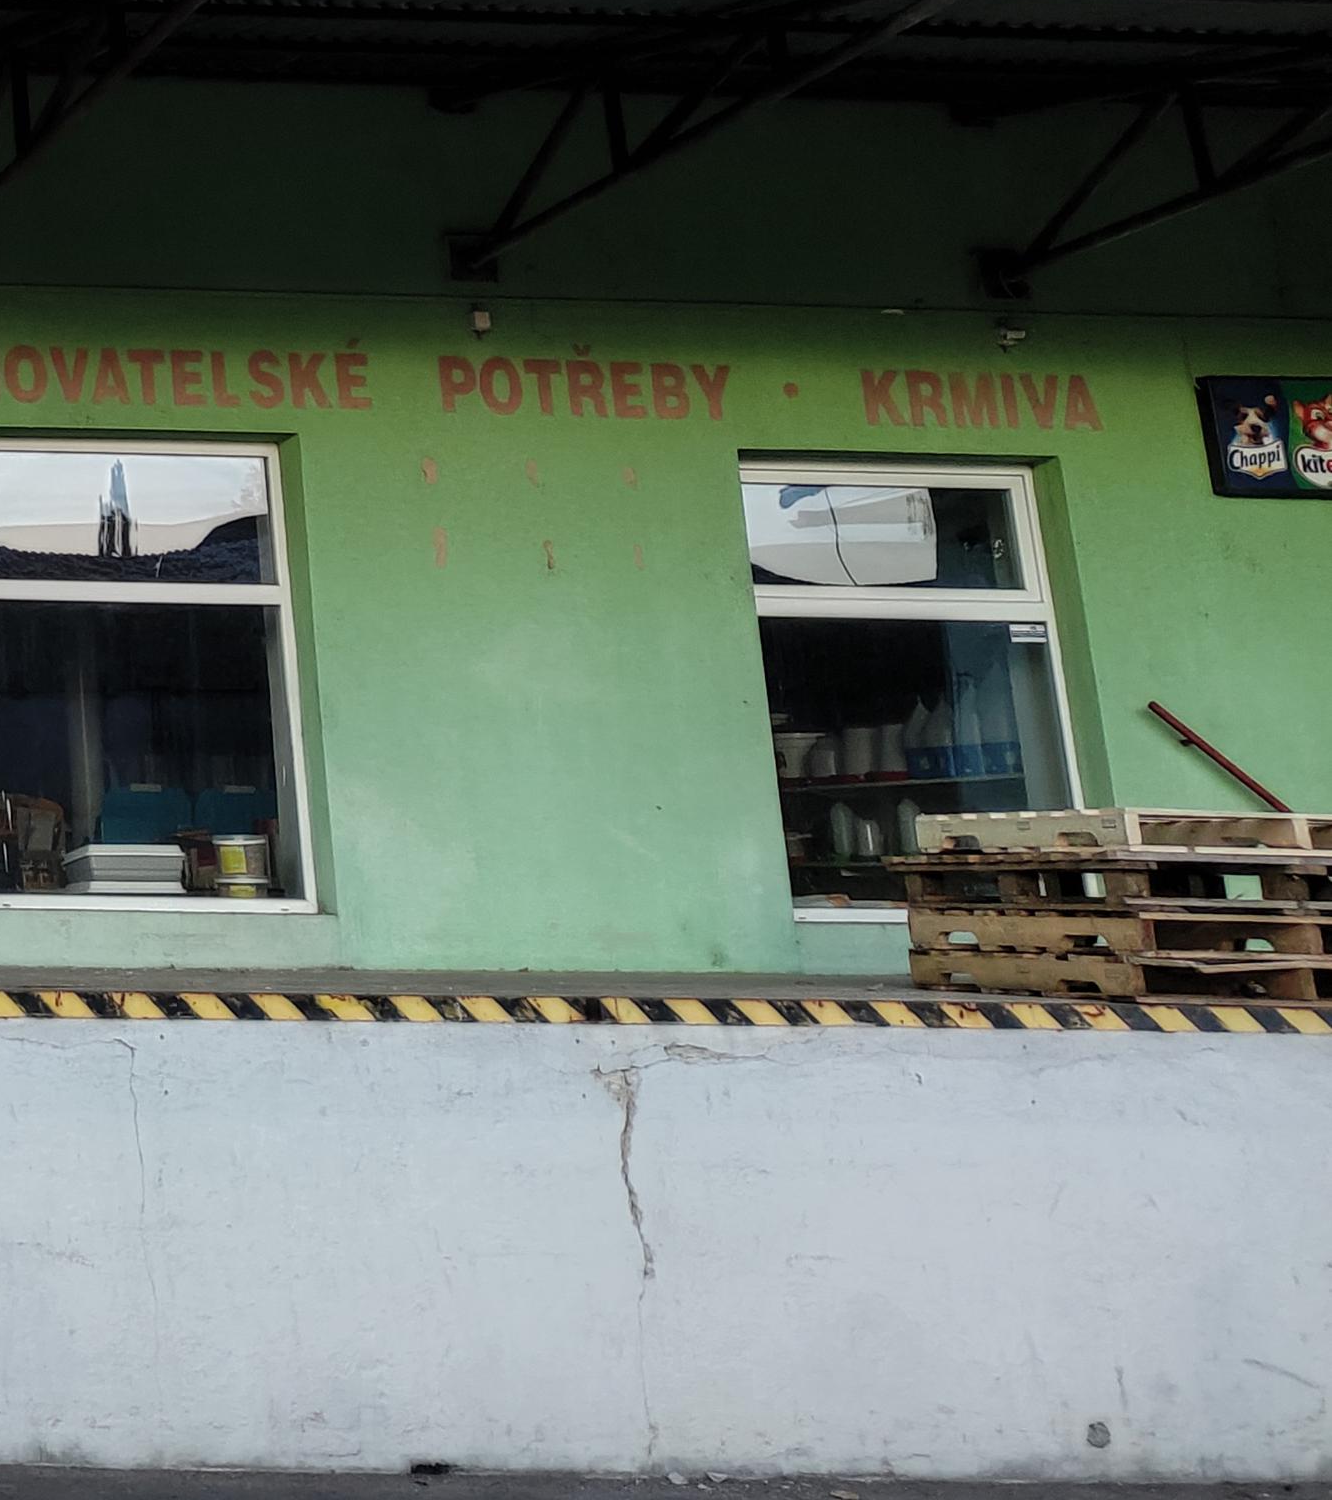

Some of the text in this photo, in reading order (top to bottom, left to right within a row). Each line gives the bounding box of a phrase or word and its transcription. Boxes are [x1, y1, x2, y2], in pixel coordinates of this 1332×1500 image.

[438, 344, 730, 421] POTŘEBY
[860, 368, 1104, 431] KRMIVA
[1228, 445, 1282, 470] Chappi
